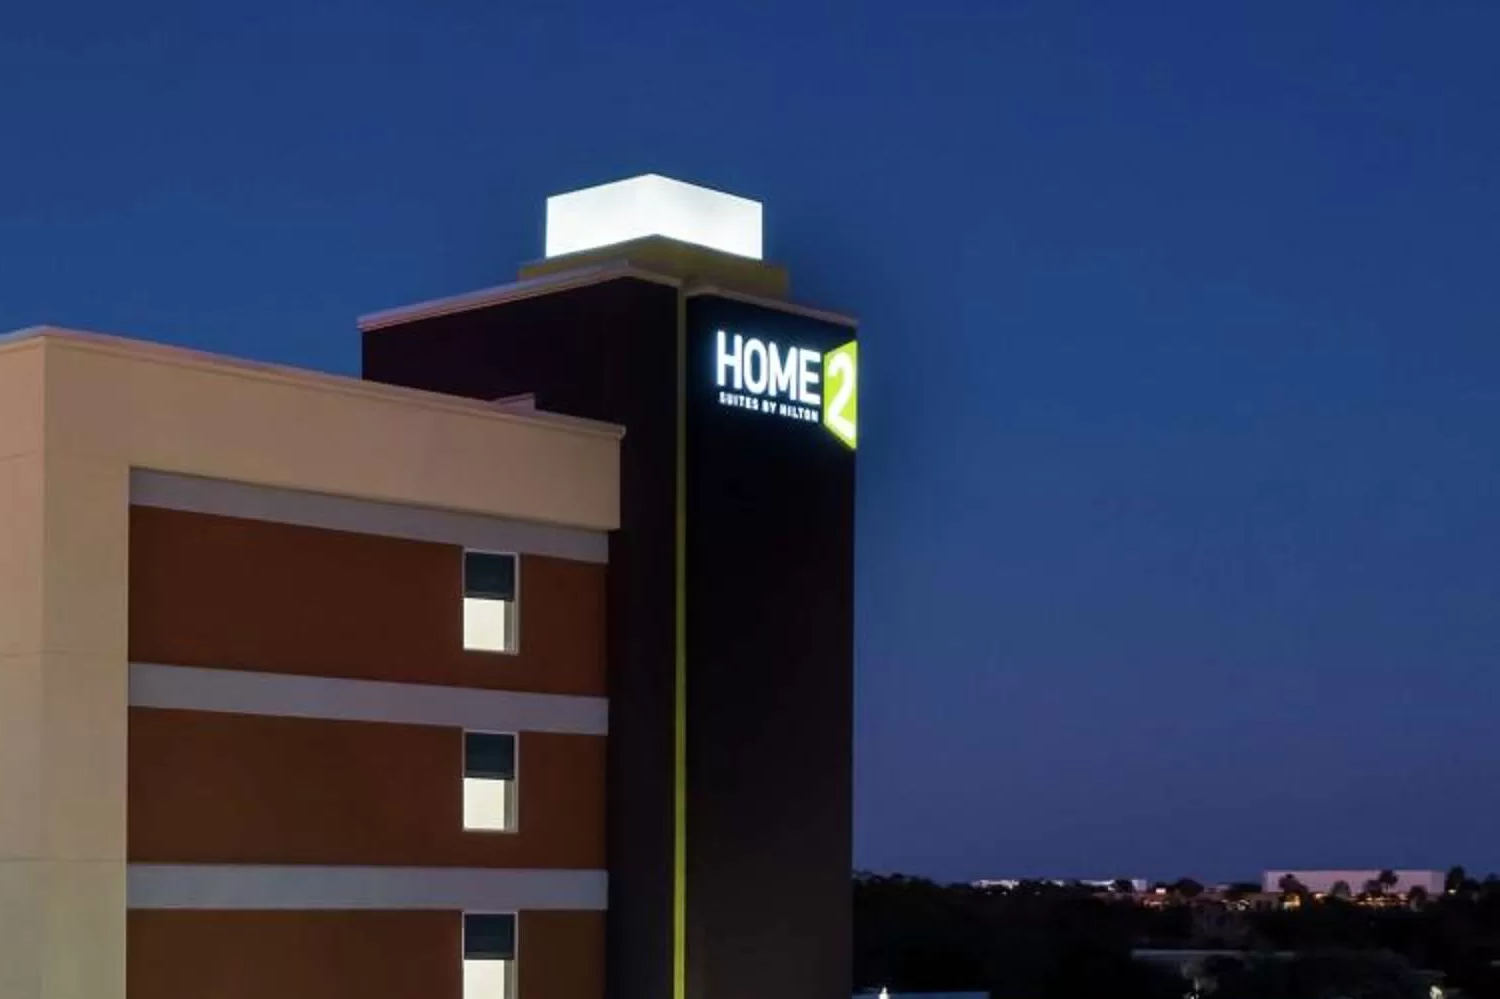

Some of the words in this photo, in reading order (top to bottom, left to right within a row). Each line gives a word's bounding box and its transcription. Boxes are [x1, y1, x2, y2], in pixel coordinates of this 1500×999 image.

[719, 391, 759, 411] SUITES
[762, 399, 777, 414] BY
[779, 403, 819, 423] HILTON
